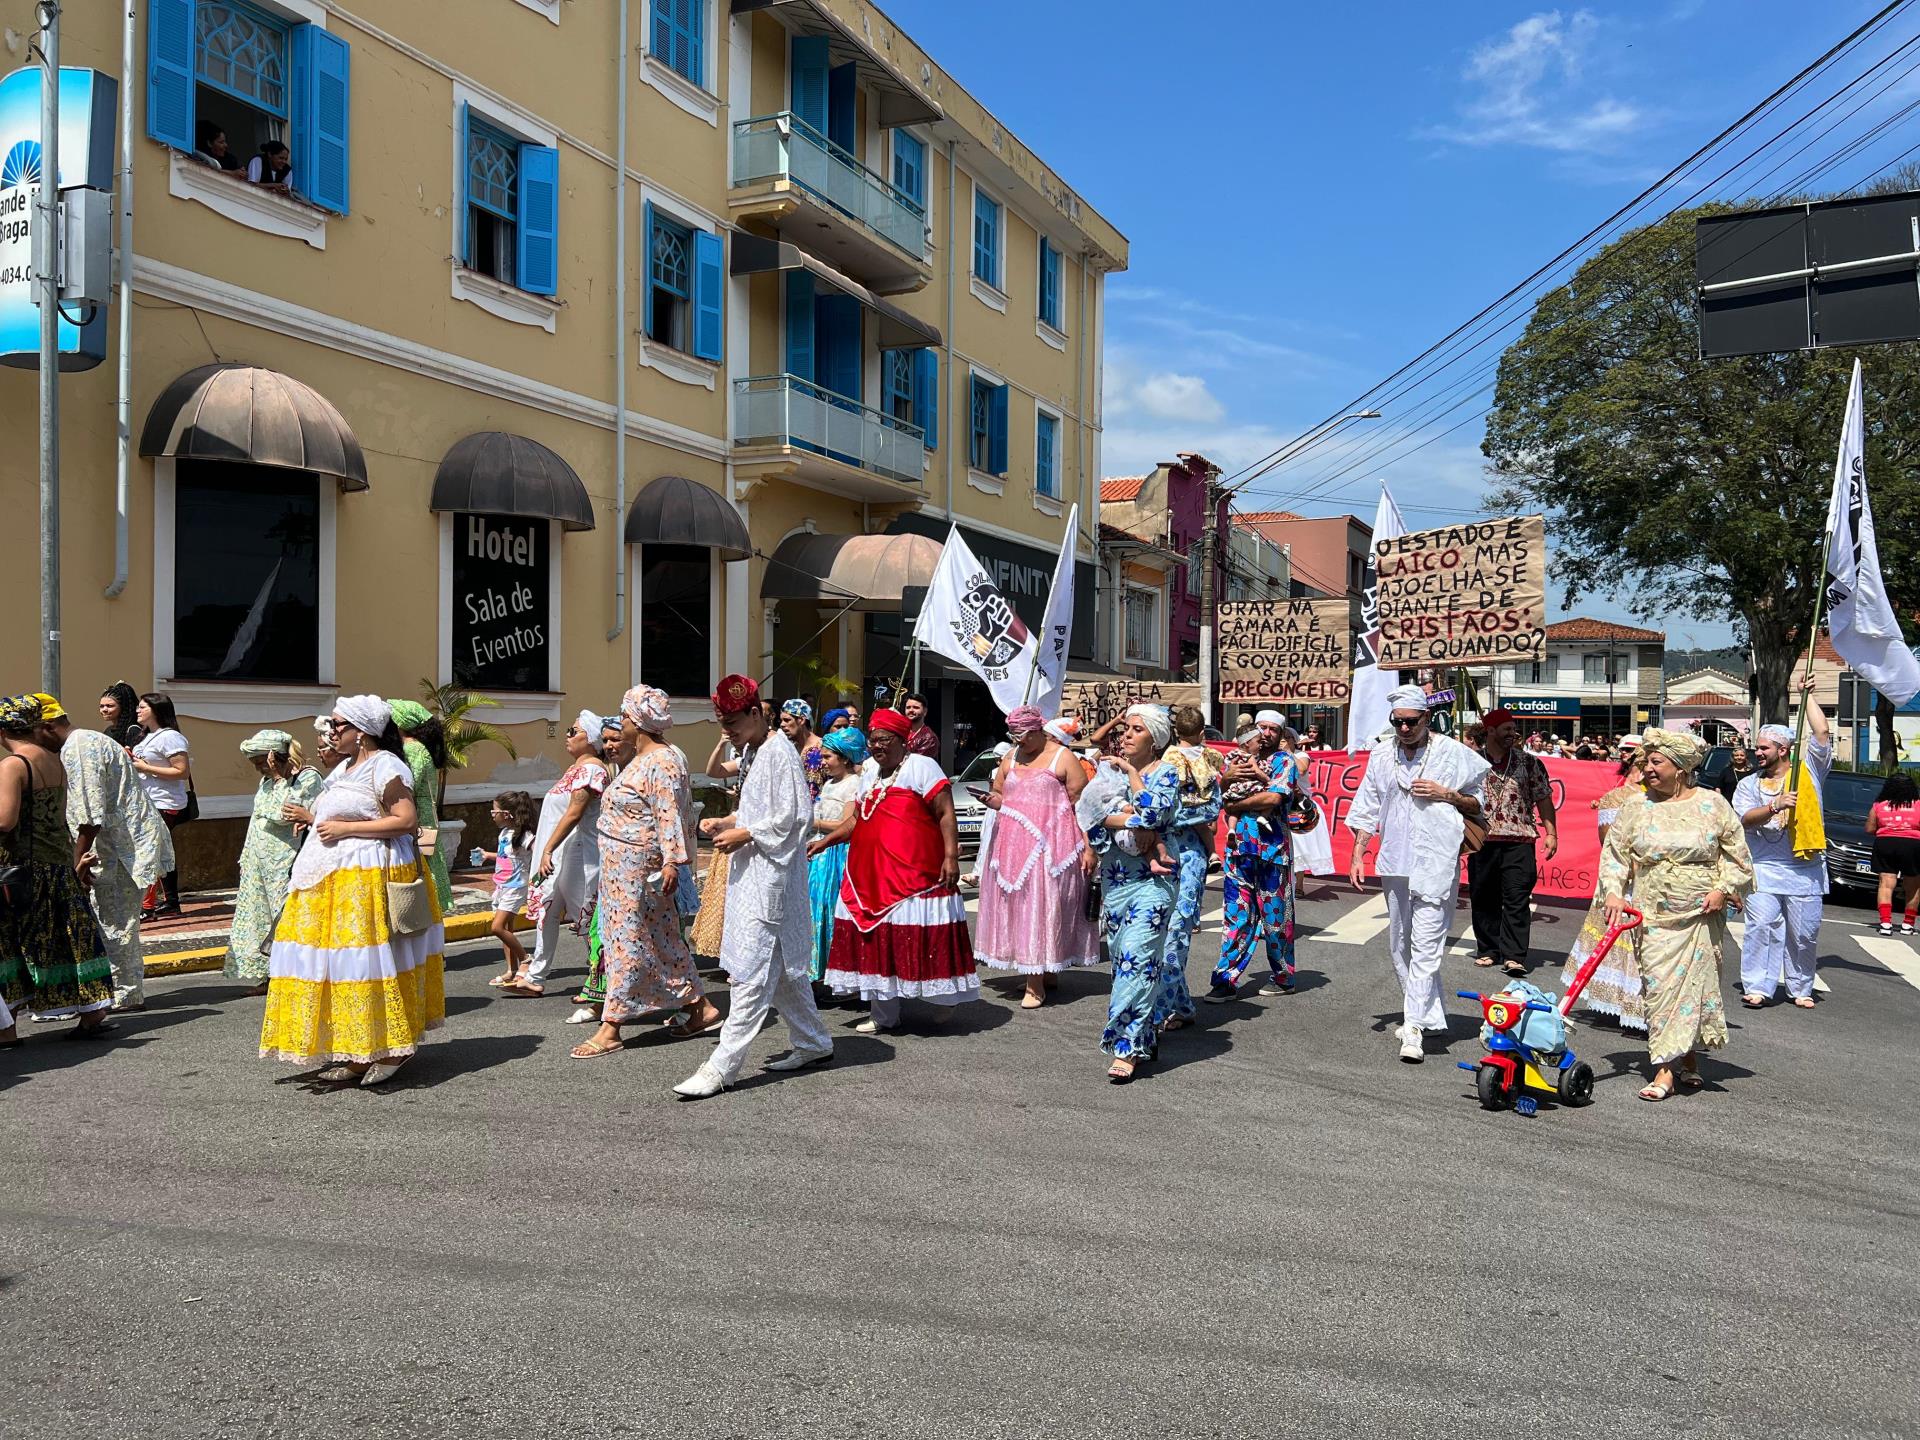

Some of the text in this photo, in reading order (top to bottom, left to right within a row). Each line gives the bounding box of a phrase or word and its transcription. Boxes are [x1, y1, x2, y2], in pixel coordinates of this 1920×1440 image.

[0, 219, 32, 243] Braga
[468, 515, 535, 567] Hotel
[1377, 517, 1523, 557] O ESTADO É
[1377, 549, 1468, 578] LAICO,
[1475, 540, 1528, 565] MAS
[1380, 562, 1527, 599] AJOELHA-SE
[465, 581, 534, 625] Sala de
[1220, 601, 1314, 617] ORAR NA
[1379, 588, 1515, 619] DIANTE DE
[1220, 617, 1299, 633] CÂMARA
[1309, 615, 1320, 632] É
[472, 625, 544, 667] Eventos
[1380, 628, 1546, 662] ATÉ QUANDO?
[1220, 652, 1343, 670] É GOVERNAR
[1262, 669, 1300, 681] SEM
[1093, 681, 1162, 699] CAPELA
[1222, 680, 1349, 699] PRECONCEITO
[1504, 701, 1557, 711] cotafácil
